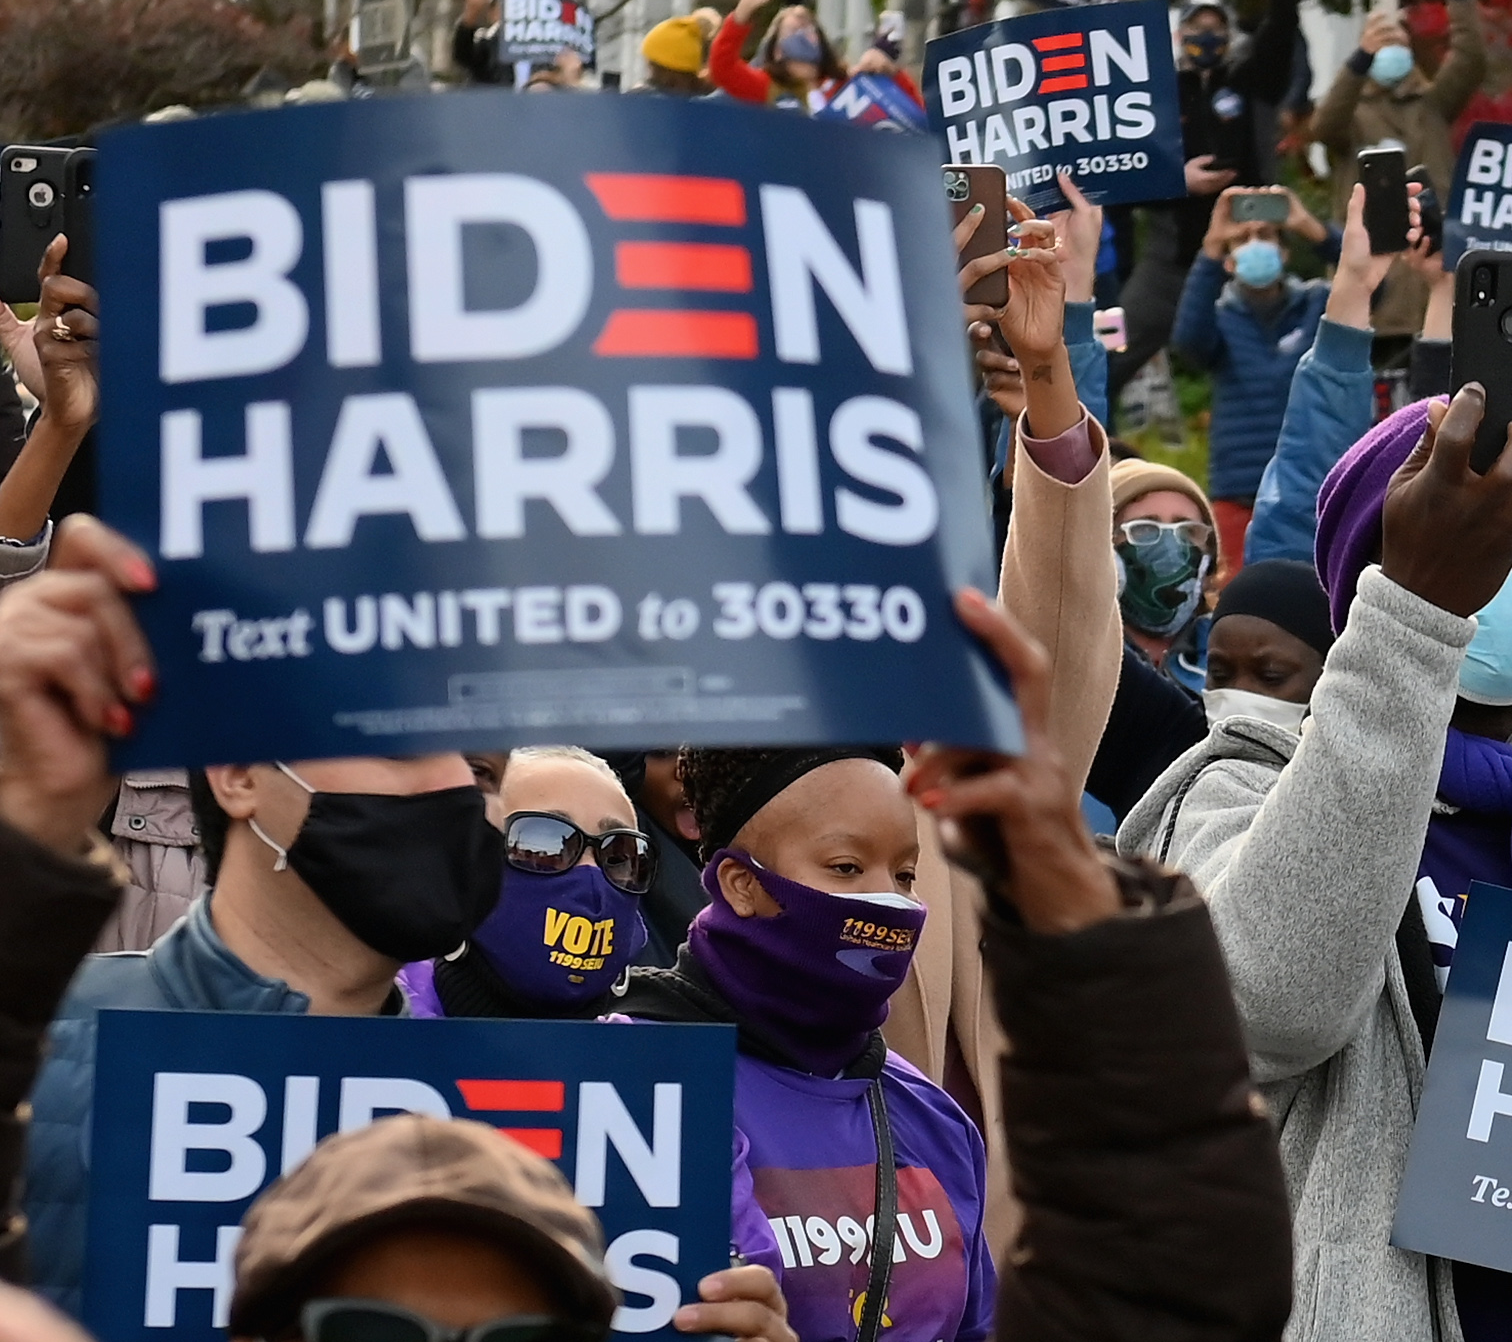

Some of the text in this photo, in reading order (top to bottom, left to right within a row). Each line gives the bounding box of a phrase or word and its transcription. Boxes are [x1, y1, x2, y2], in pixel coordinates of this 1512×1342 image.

[938, 25, 1150, 118] BIDEN
[946, 90, 1157, 165] HARRIS
[1005, 163, 1053, 191] NITED
[1076, 152, 1148, 176] 30330
[158, 171, 915, 384] BIDEN
[158, 385, 940, 560] HARRIS
[193, 581, 928, 663] Text UNITED to 30330
[543, 907, 615, 956] VOTE
[548, 950, 605, 971] 1199SEIU
